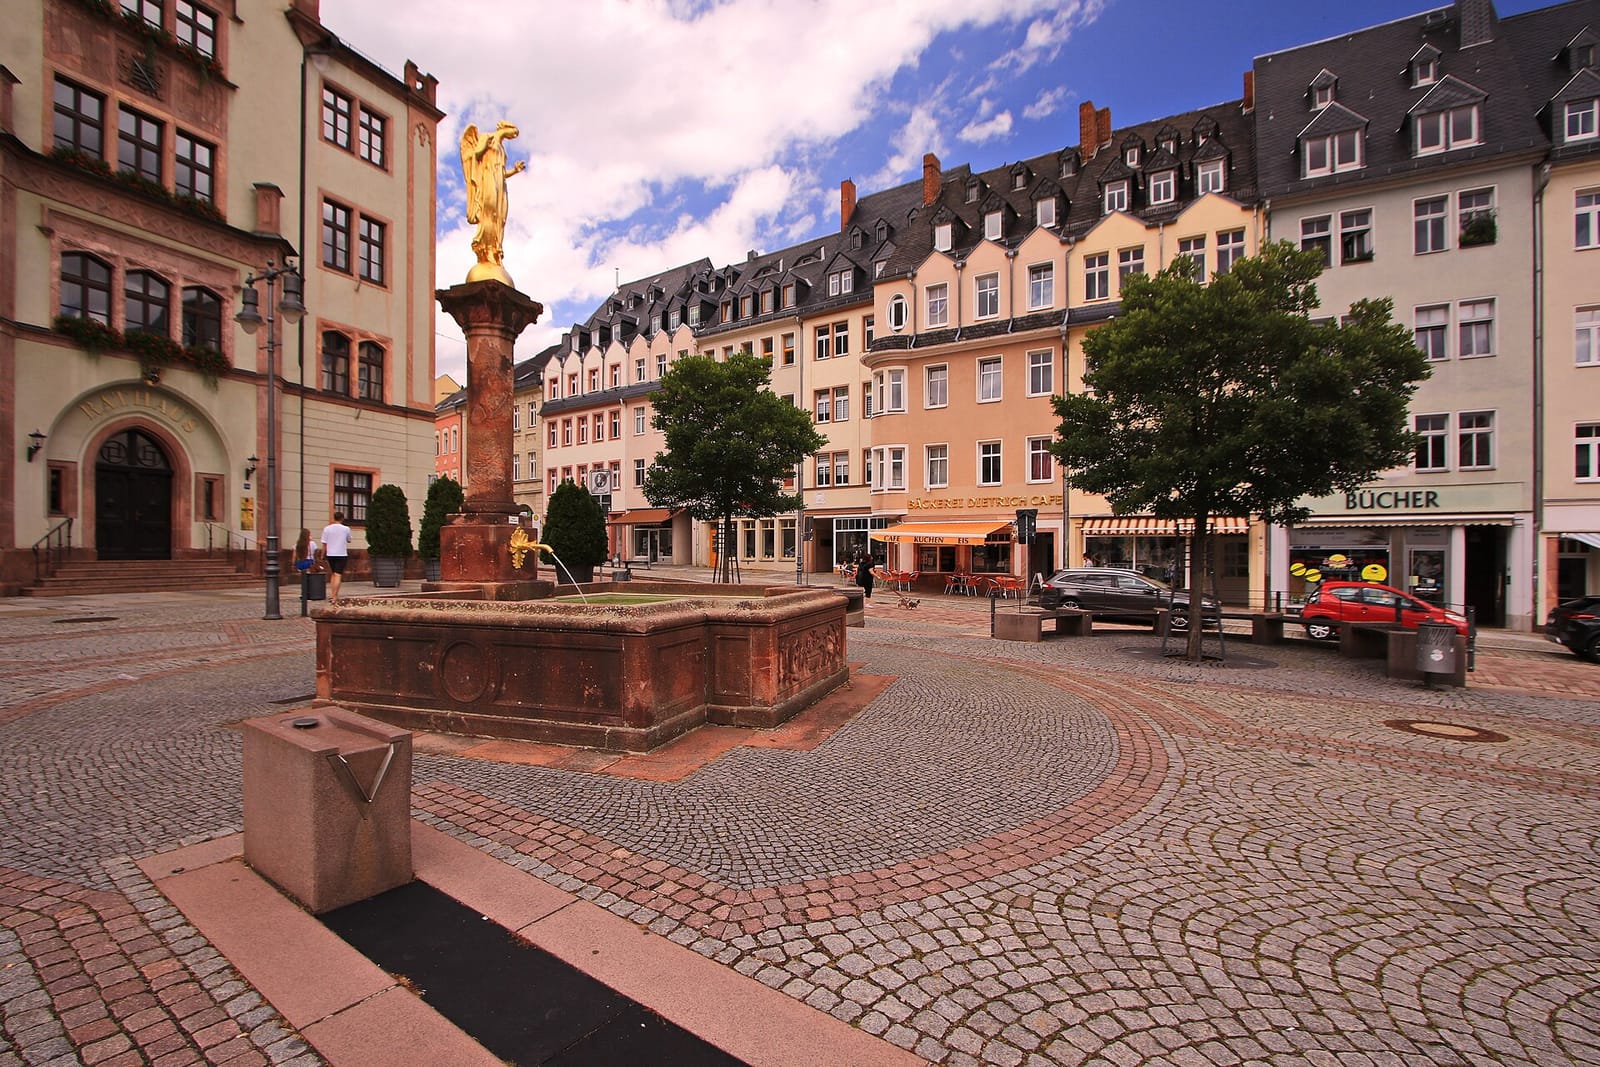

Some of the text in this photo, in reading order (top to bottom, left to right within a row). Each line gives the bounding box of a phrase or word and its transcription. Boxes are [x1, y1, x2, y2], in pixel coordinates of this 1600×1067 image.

[80, 390, 195, 432] RATHAUS
[908, 498, 963, 509] BÄCKEREI
[968, 496, 1027, 508] DIETRICH
[1346, 490, 1439, 509] BÜCHER
[913, 535, 944, 543] KUCHEN
